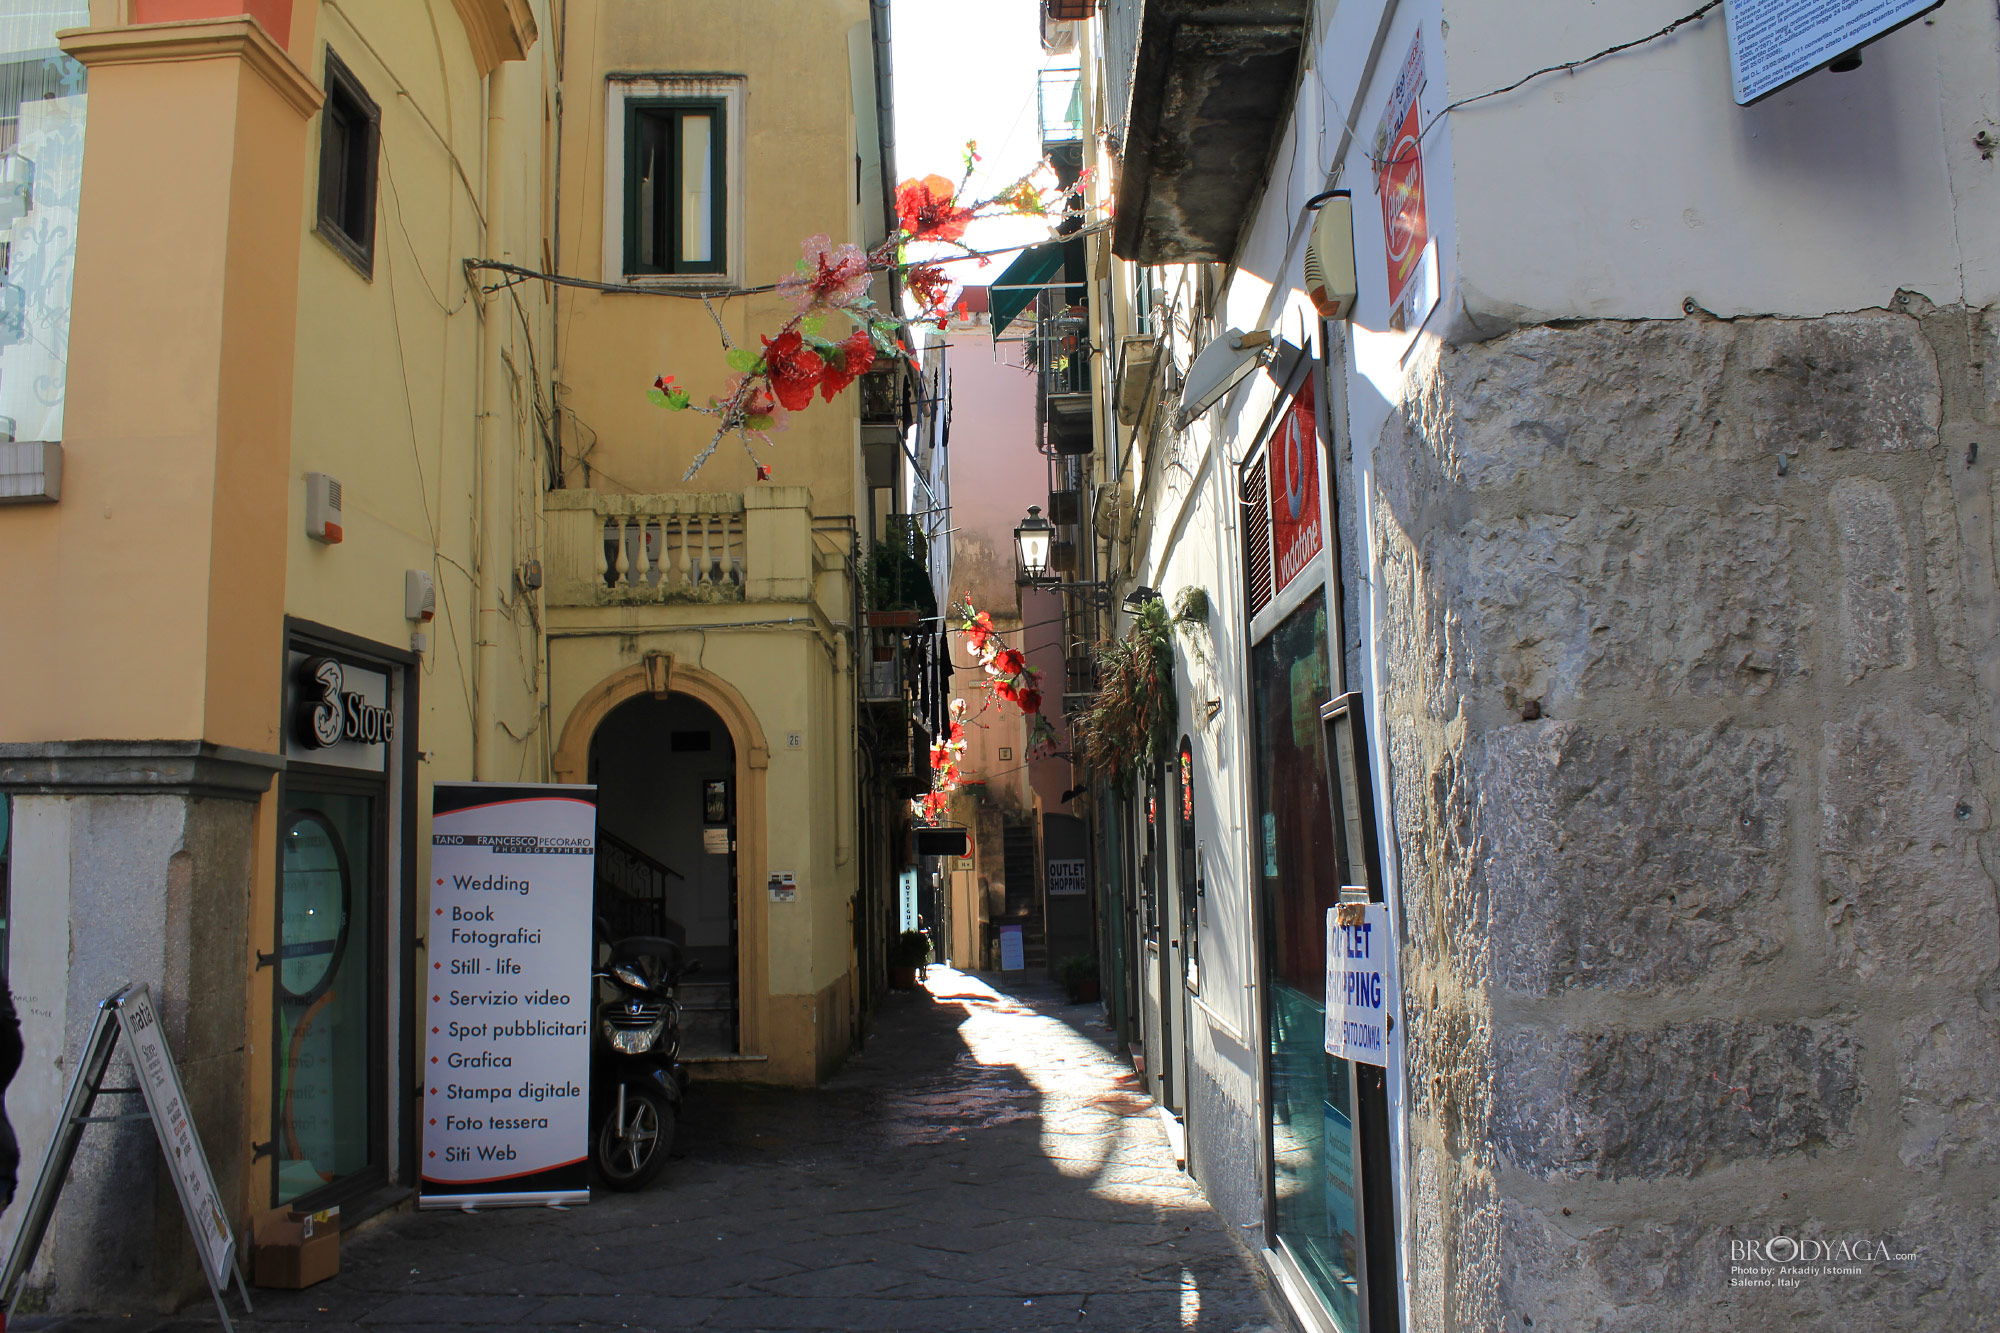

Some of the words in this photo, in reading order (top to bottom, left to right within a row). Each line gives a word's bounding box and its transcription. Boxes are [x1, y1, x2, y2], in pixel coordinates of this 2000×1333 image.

[1281, 519, 1318, 585] vodafone
[346, 692, 394, 742] Store
[789, 735, 799, 746] 26
[436, 836, 464, 845] TANO
[478, 836, 536, 846] FRANCESCO
[539, 838, 590, 846] PECORARO
[1050, 863, 1085, 876] OUTLET
[453, 875, 530, 895] Wedding
[1050, 877, 1085, 891] SHOPPING
[452, 905, 494, 921] Book
[452, 928, 541, 948] Fotografici
[1332, 922, 1372, 959] OULET
[451, 958, 480, 974] Still
[496, 958, 521, 974] life
[450, 990, 518, 1005] Servizio
[524, 989, 570, 1005] video
[129, 1002, 153, 1034] matia
[449, 1022, 487, 1041] Spot
[494, 1020, 587, 1040] pubblicitari
[448, 1051, 512, 1068] Grafica
[447, 1083, 512, 1103] Stampa
[519, 1081, 580, 1102] digitale
[447, 1115, 483, 1131] Foto
[489, 1116, 548, 1129] tessera
[446, 1147, 470, 1162] Siti
[477, 1144, 517, 1160] Web
